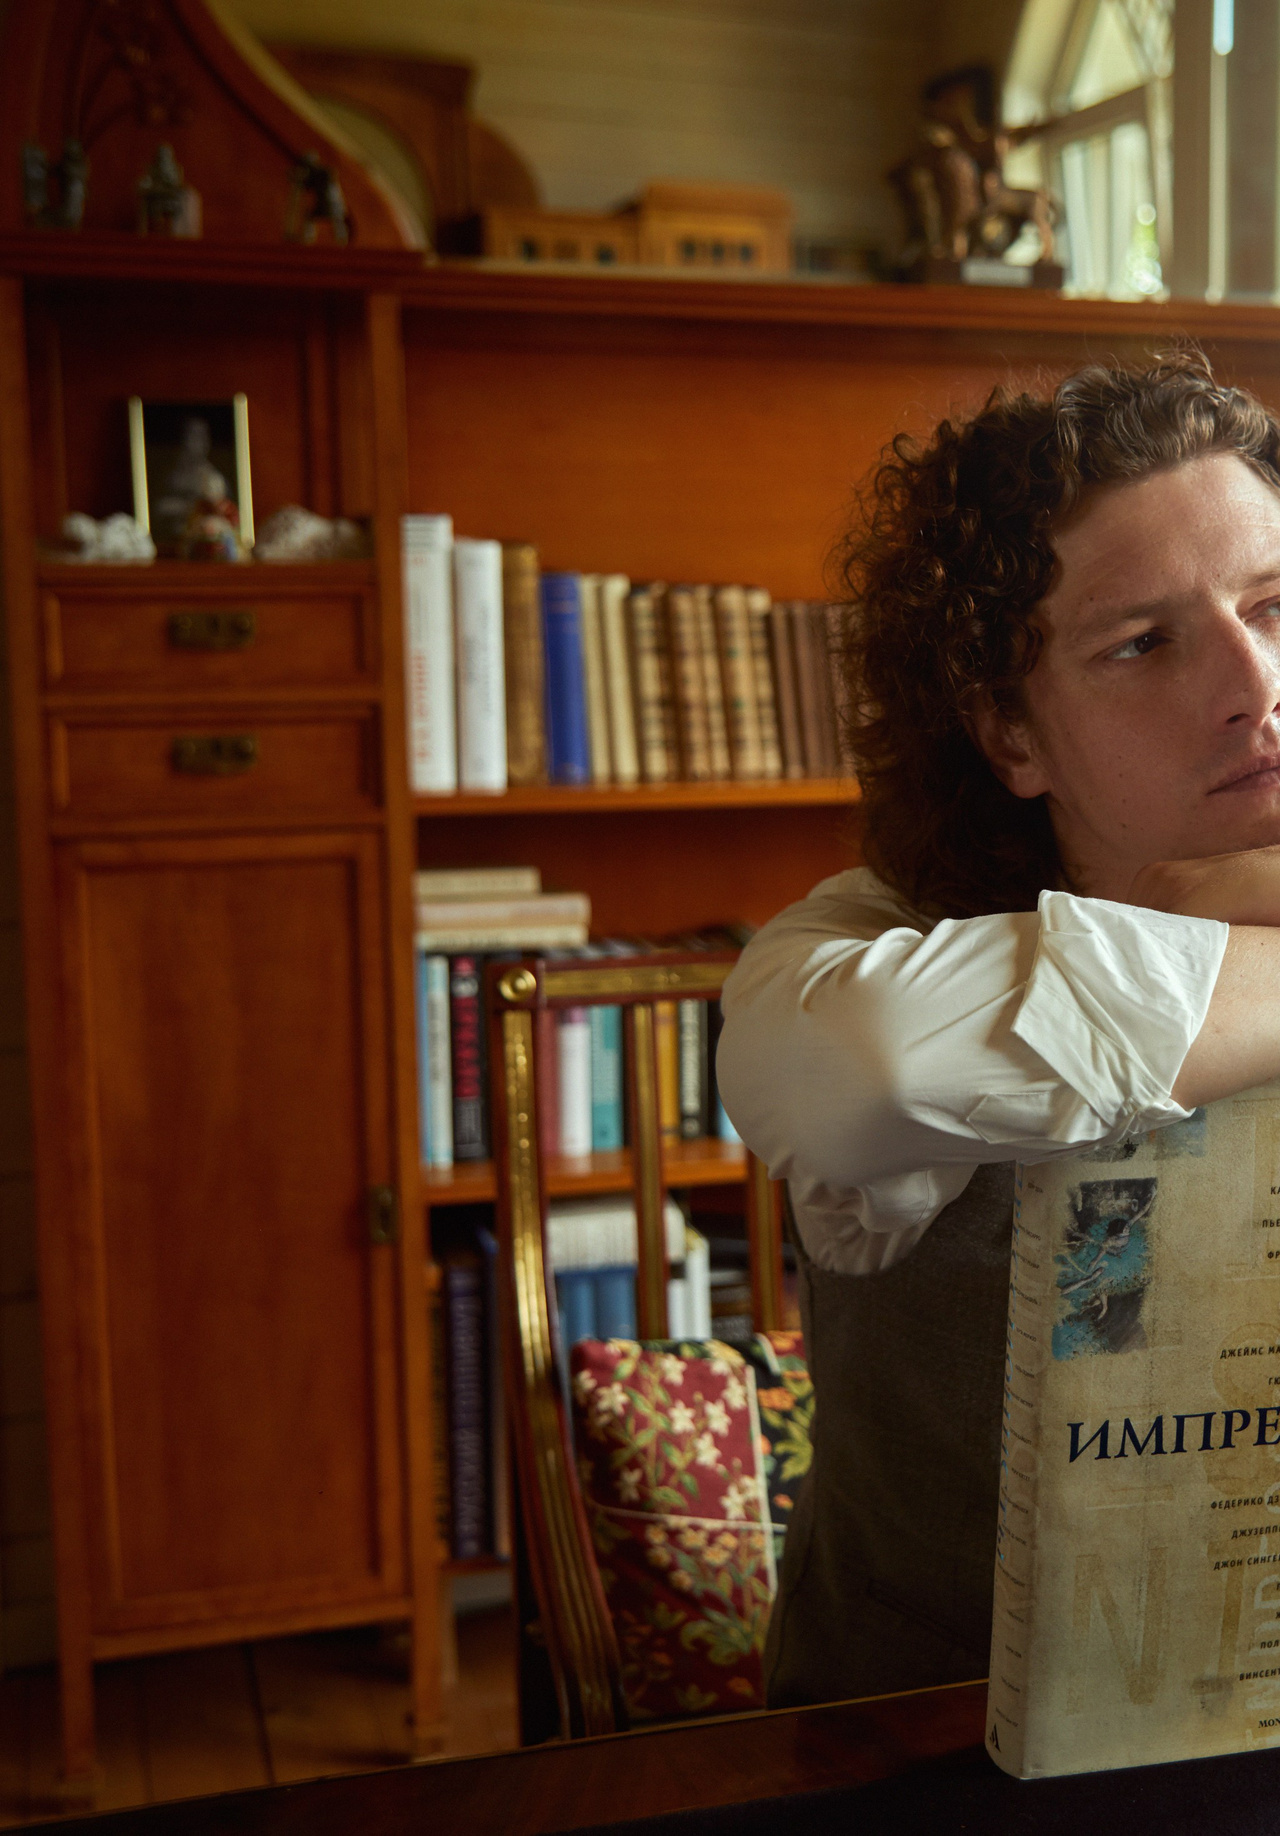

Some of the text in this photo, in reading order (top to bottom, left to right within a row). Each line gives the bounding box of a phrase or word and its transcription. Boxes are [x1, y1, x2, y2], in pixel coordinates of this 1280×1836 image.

[1219, 1346, 1265, 1360] ДЖЕЙМС
[1210, 1496, 1264, 1511] ФЕДЕРИКО
[1213, 1557, 1243, 1572] ДЖОН
